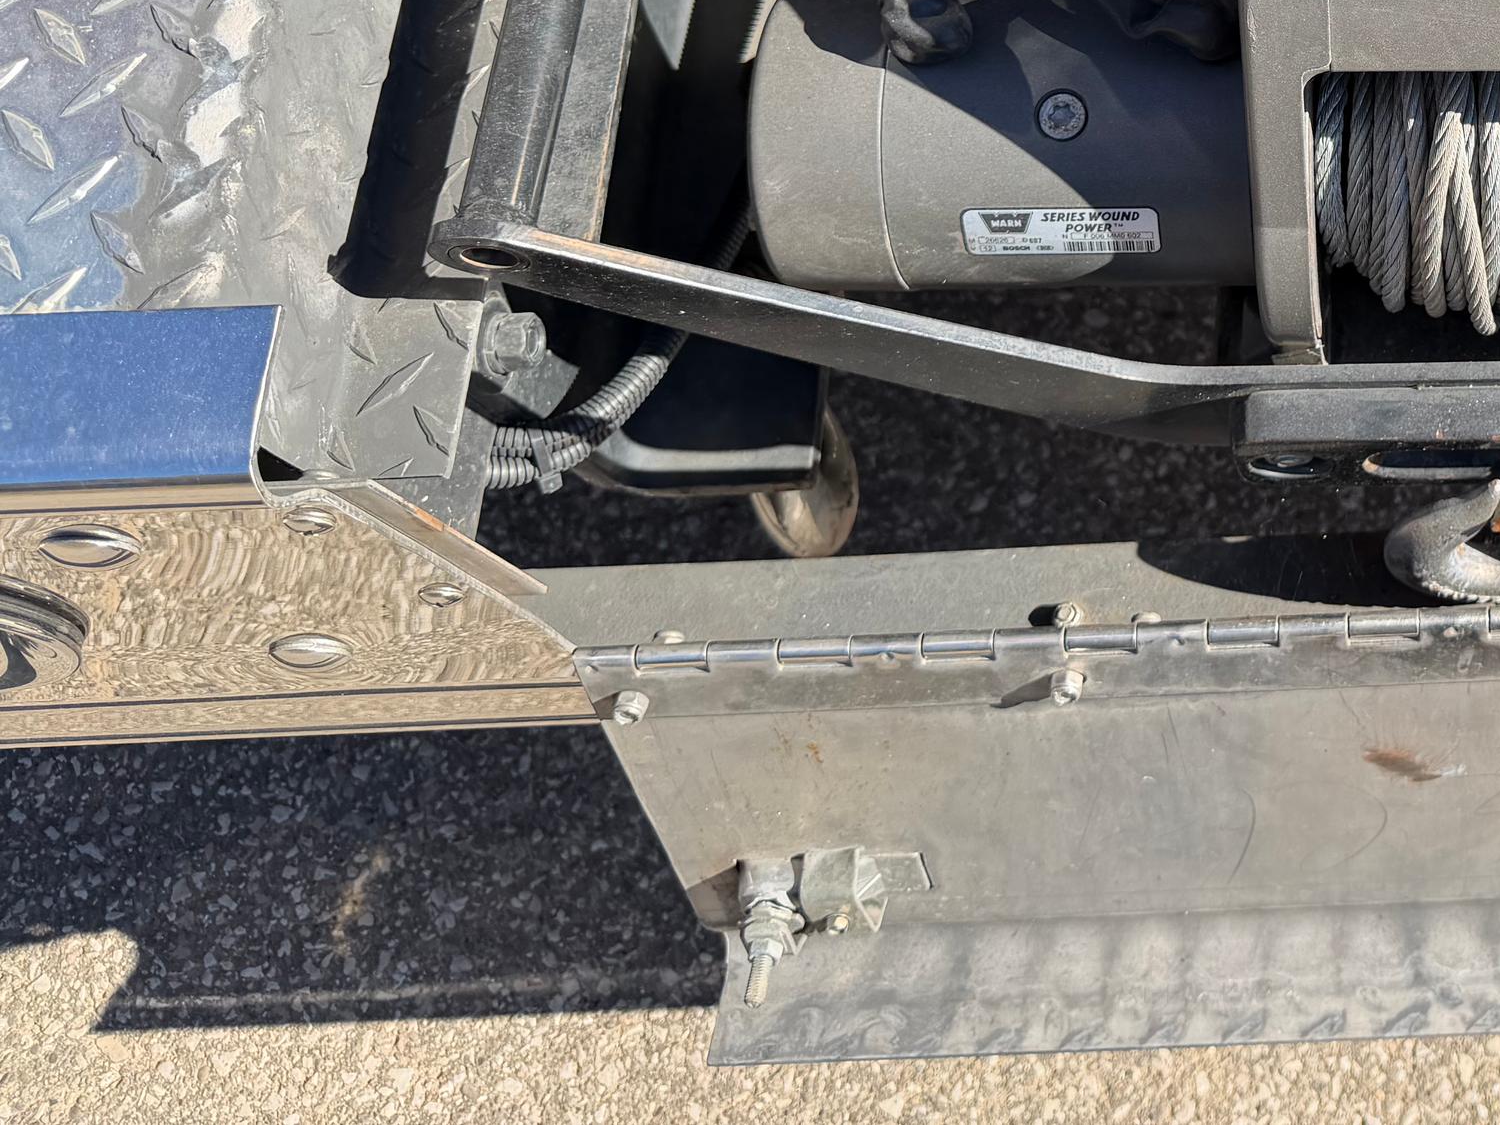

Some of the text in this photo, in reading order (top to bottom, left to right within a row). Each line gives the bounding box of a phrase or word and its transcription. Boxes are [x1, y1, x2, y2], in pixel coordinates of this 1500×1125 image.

[1041, 211, 1140, 222] SERIES WOUND
[990, 219, 1023, 228] WARN
